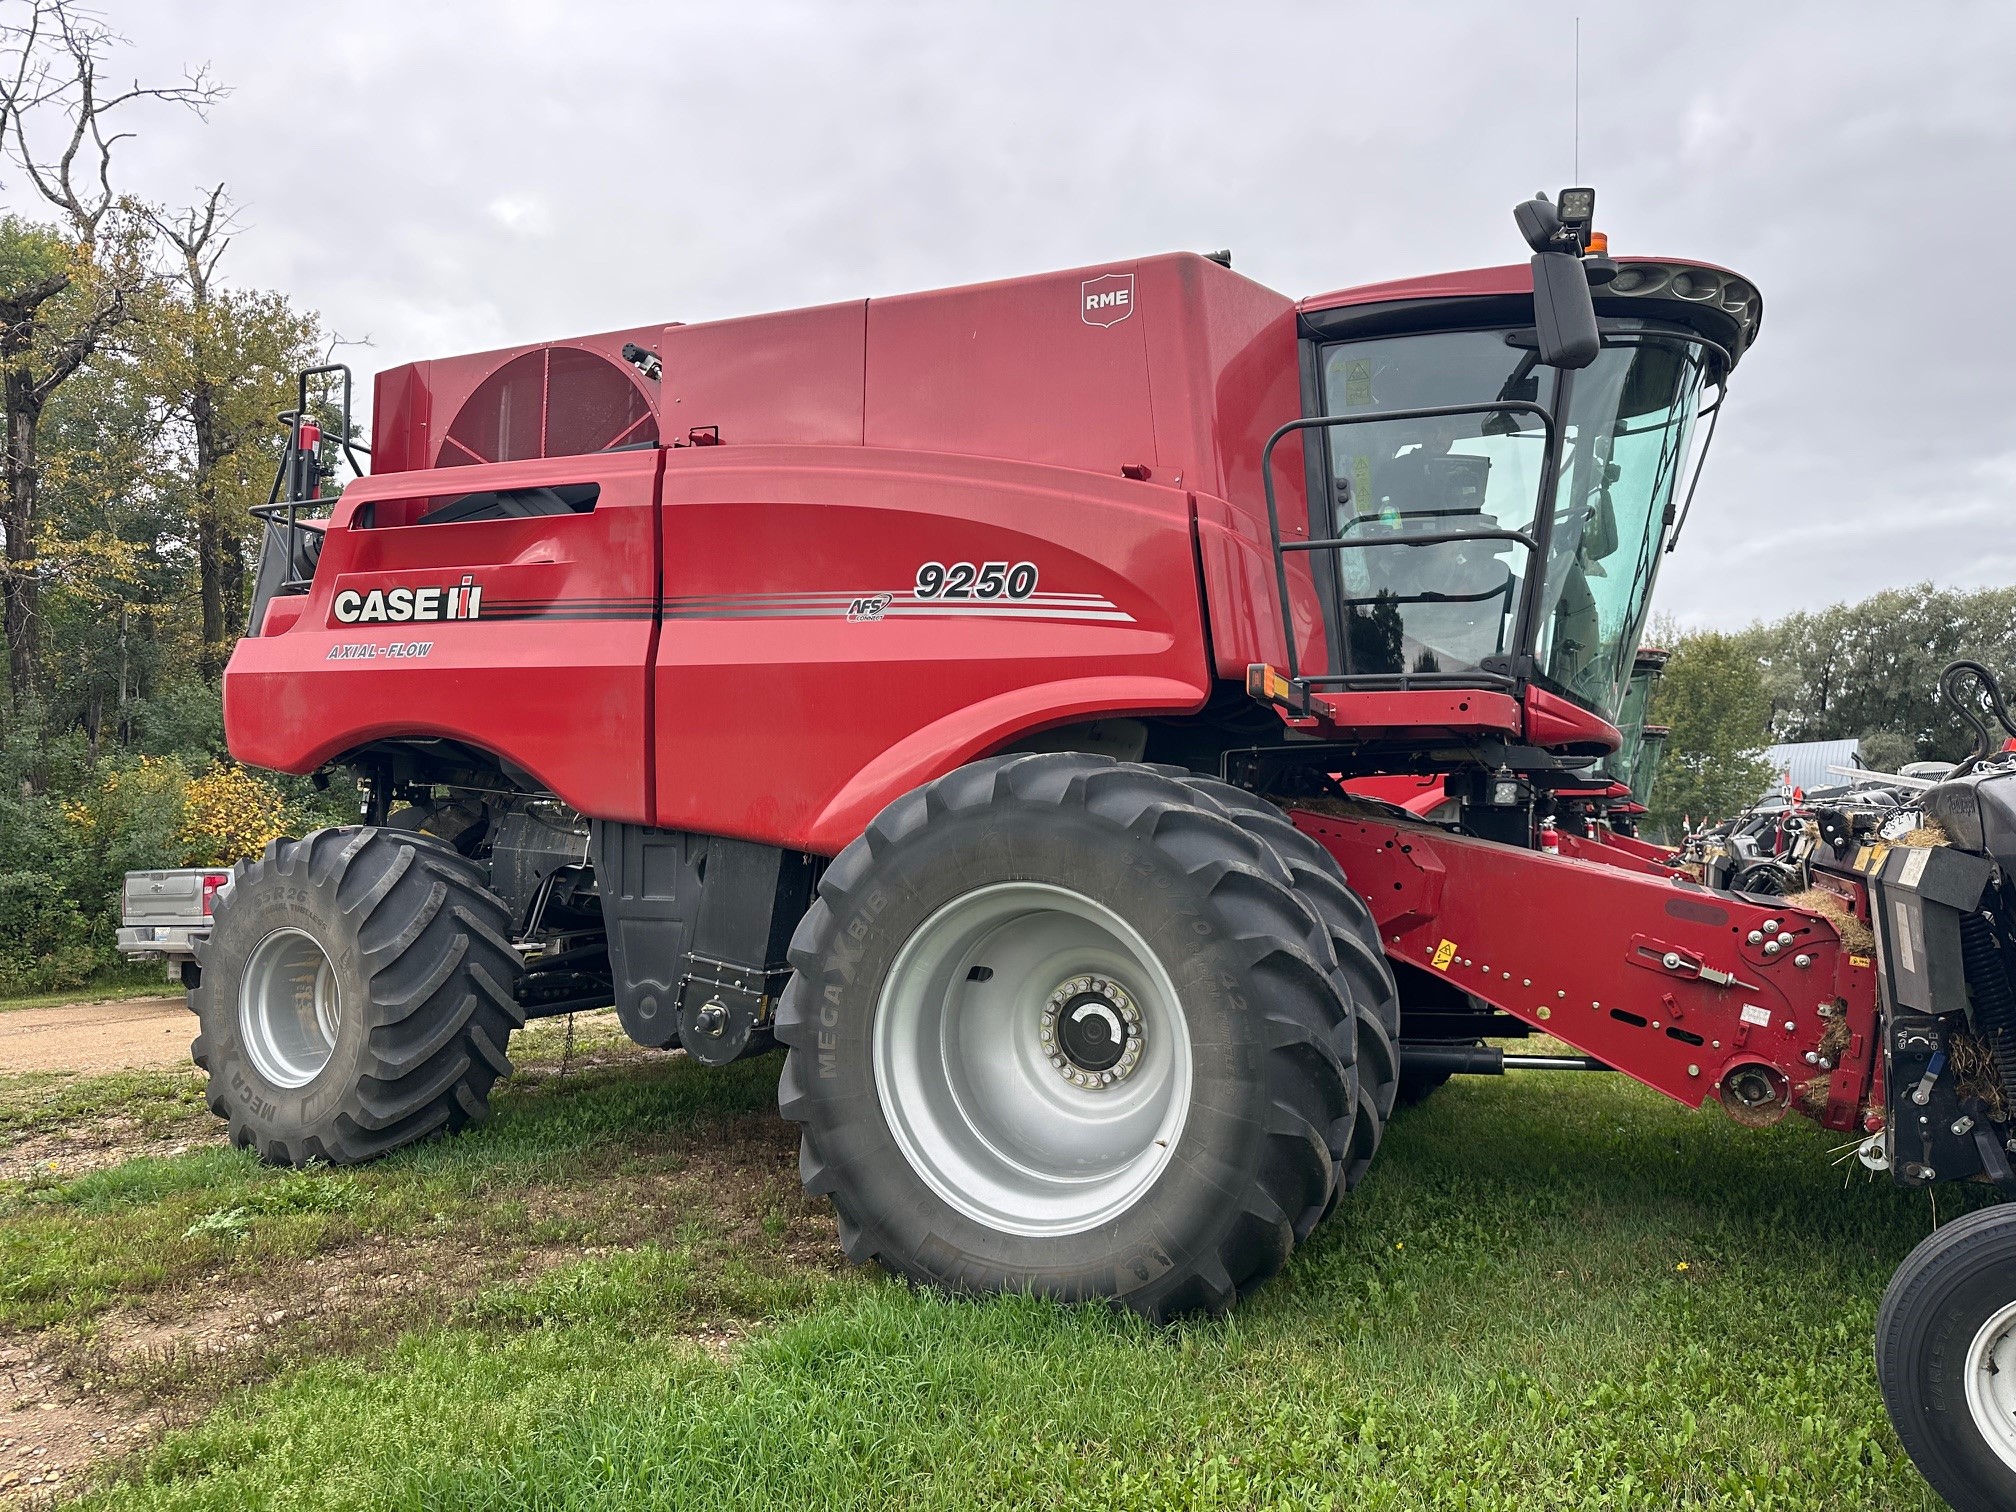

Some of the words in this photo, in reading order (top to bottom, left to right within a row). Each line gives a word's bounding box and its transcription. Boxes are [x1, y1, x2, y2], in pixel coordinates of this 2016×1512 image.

[1086, 289, 1129, 310] RME
[914, 561, 1038, 600] 9250
[334, 588, 441, 623] CASE
[847, 598, 883, 615] AFS
[327, 642, 433, 660] AXIAL-FLOW
